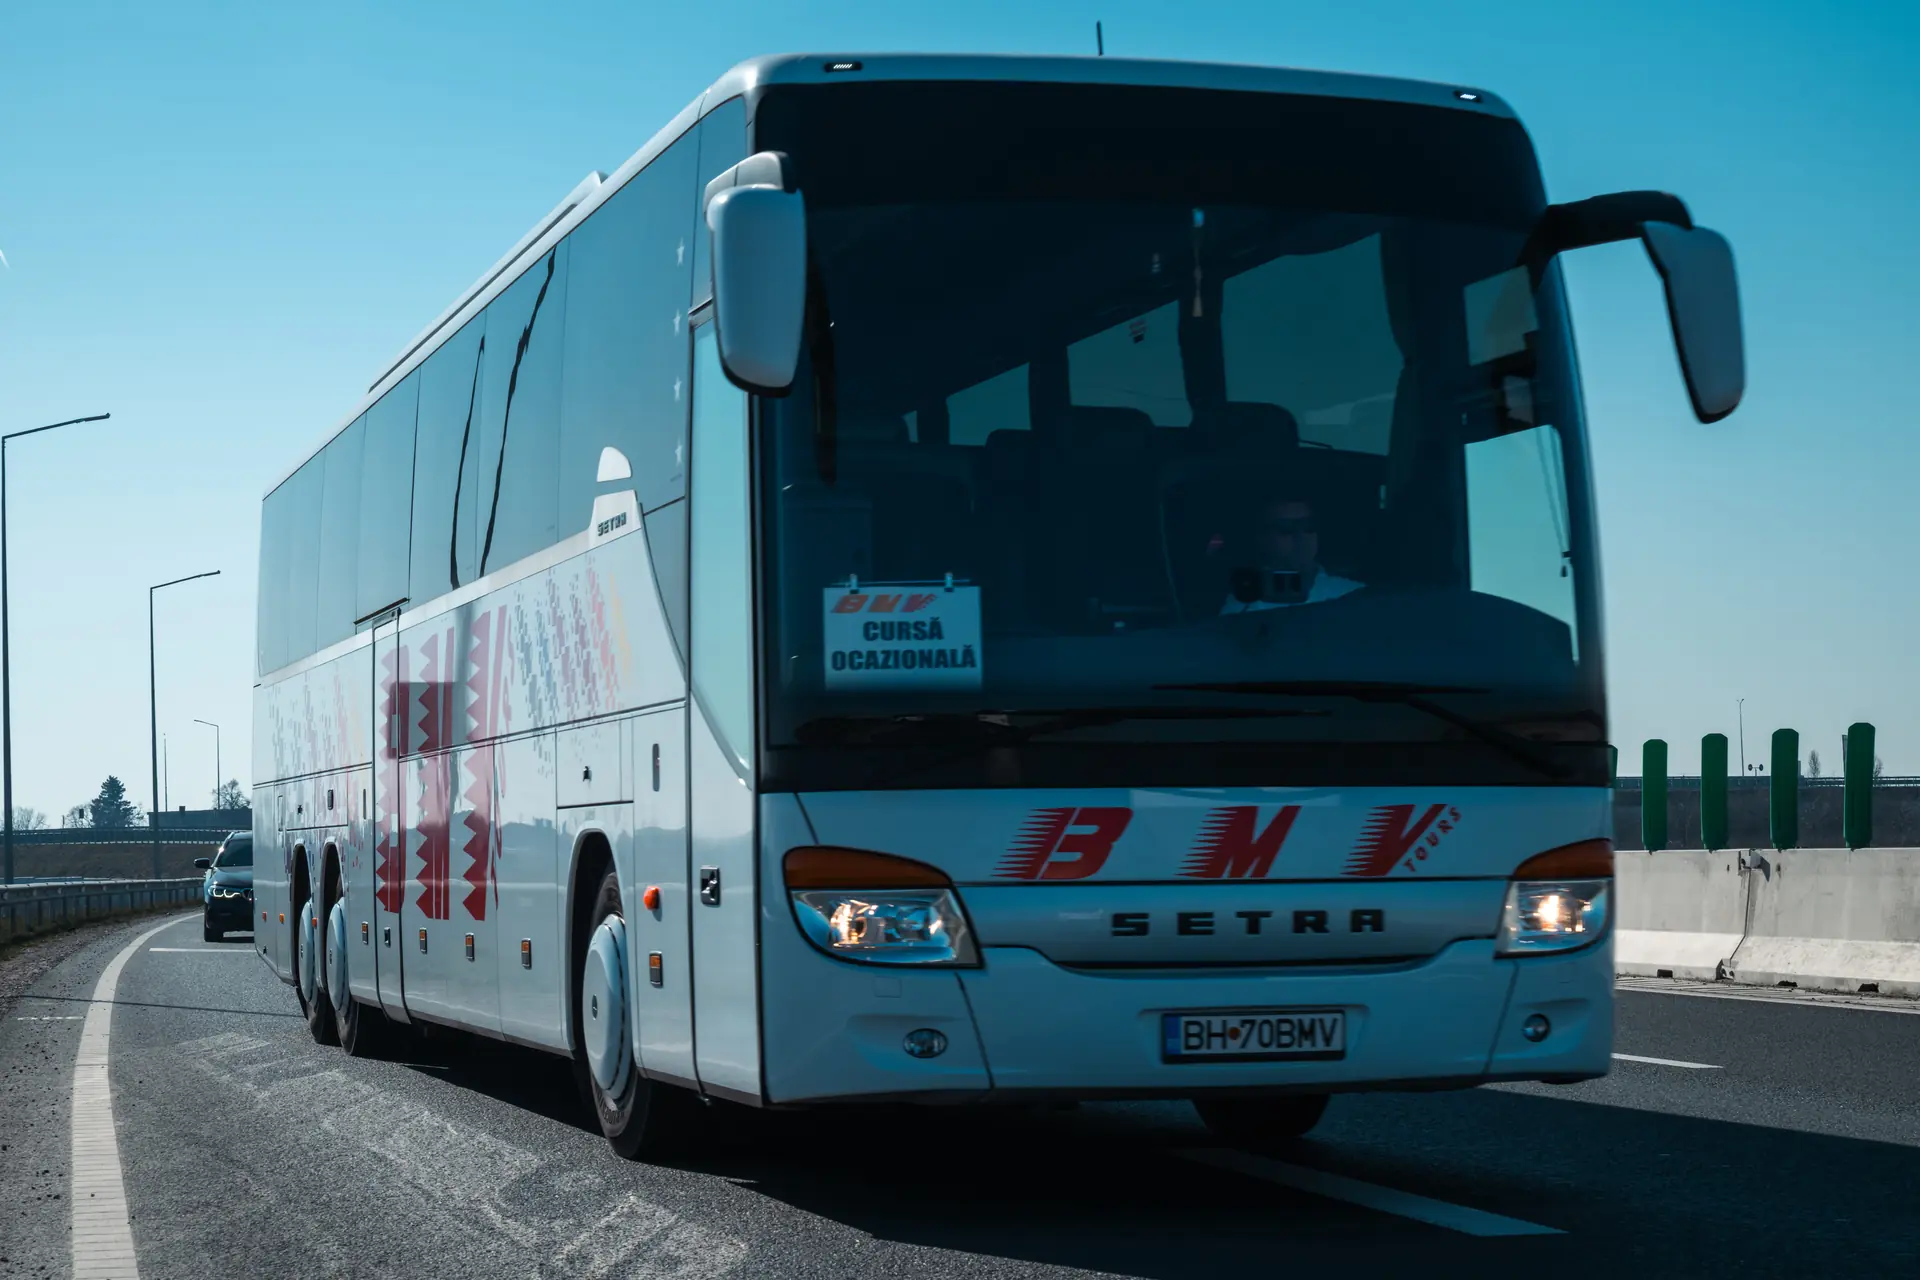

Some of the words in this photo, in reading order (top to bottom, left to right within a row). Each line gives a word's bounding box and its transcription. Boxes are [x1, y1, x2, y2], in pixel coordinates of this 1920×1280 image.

[863, 617, 944, 642] CURSĂ
[831, 645, 977, 671] OCAZIONALĂ
[1402, 806, 1462, 873] TOURS
[1111, 909, 1386, 937] SETRA
